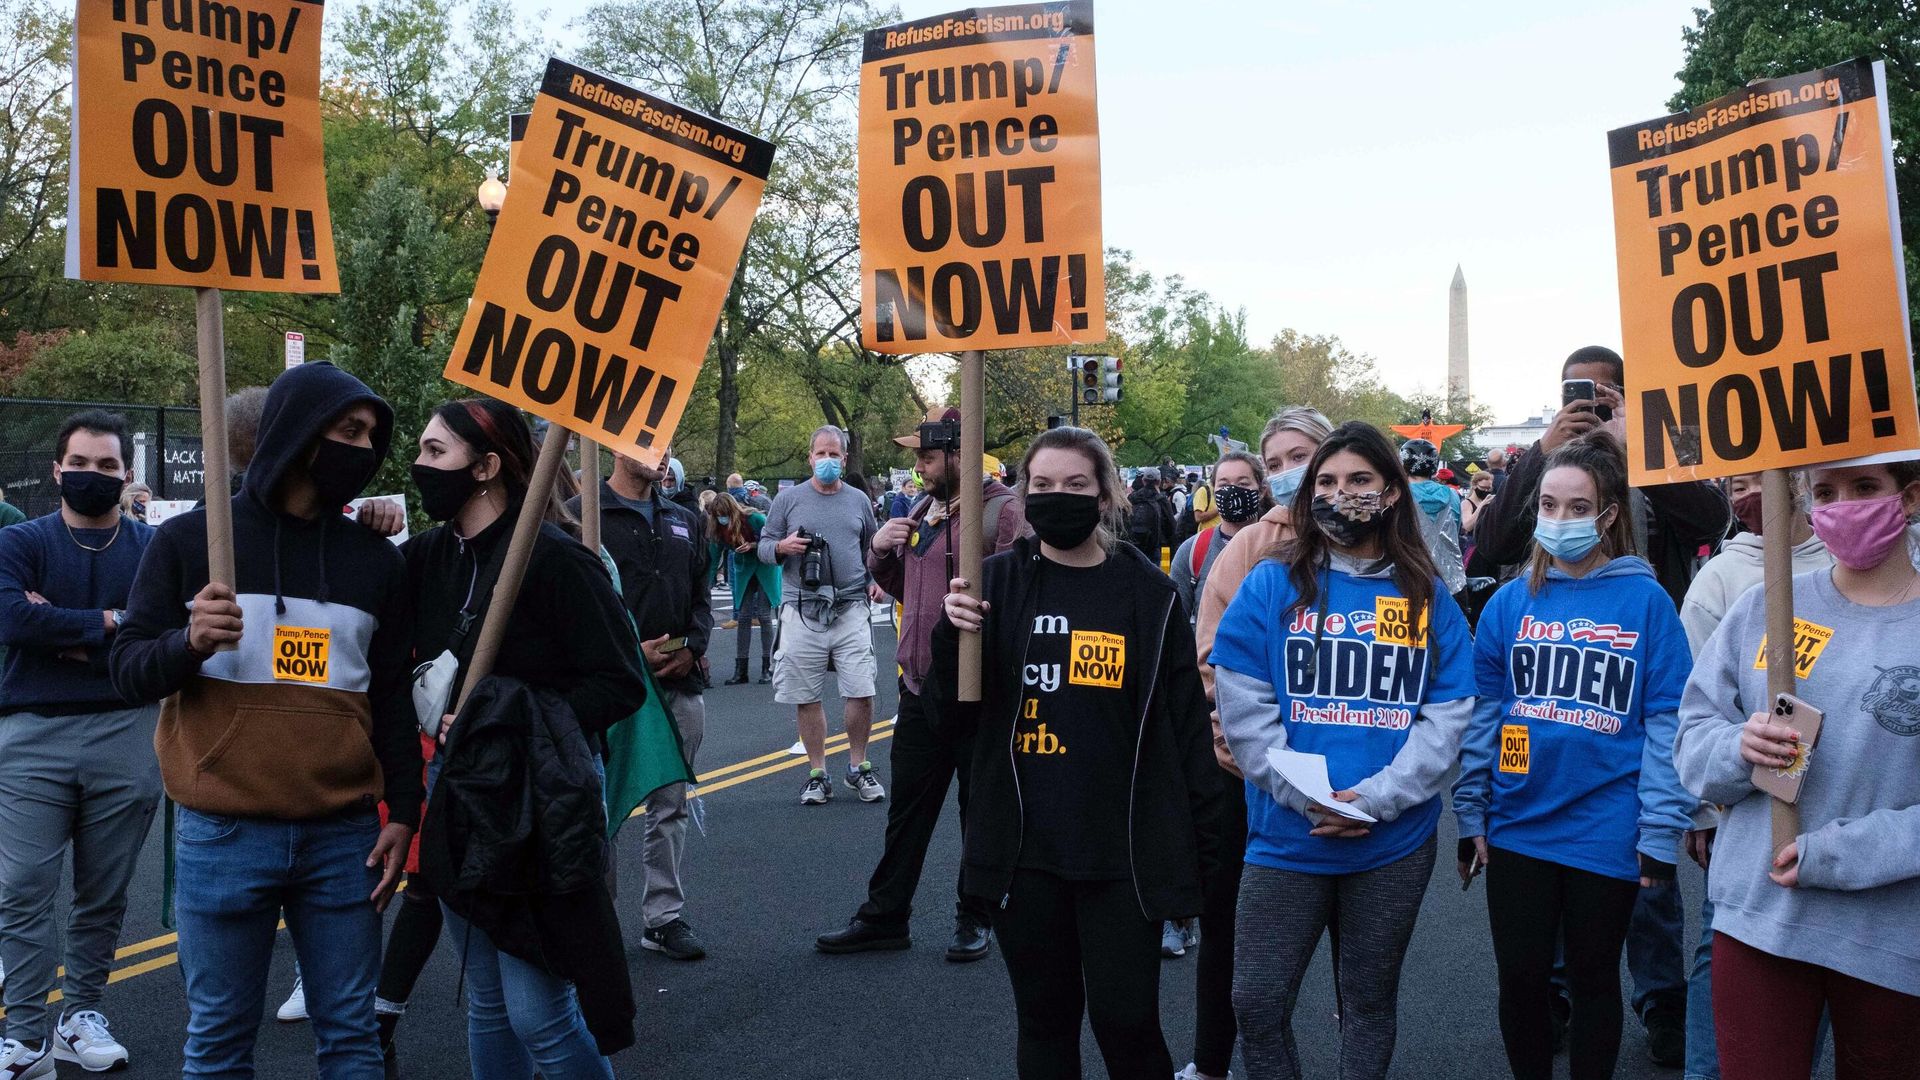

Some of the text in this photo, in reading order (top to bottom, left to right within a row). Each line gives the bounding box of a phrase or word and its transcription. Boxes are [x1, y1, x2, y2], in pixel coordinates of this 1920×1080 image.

[886, 11, 1064, 50] RefuseFascism.org
[121, 32, 286, 108] Pence
[880, 43, 1070, 111] Trump/
[132, 98, 284, 193] OUT
[570, 73, 747, 163] RefuseFascism.org
[893, 114, 1059, 166] Pence
[1637, 76, 1841, 151] RefuseFascism.org
[552, 109, 743, 221] Trump/
[1636, 111, 1850, 219] Trump/
[96, 187, 322, 281] NOW!
[542, 168, 701, 272] Pence
[902, 165, 1056, 253] OUT
[1658, 194, 1840, 277] Pence
[526, 234, 683, 352] OUT
[875, 254, 1089, 343] NOW!
[1671, 251, 1839, 368] OUT
[462, 301, 678, 449] NOW!
[1641, 348, 1897, 471] NOW!
[164, 449, 197, 464] LACK
[276, 628, 330, 640] Trump/Pence
[281, 640, 323, 659] OUT
[1074, 633, 1124, 645] Trump/Pence
[1289, 605, 1346, 634] Joe
[1383, 608, 1410, 624] OU
[1516, 615, 1564, 641] Joe
[1794, 632, 1821, 653] UT
[276, 657, 327, 677] NOW
[1073, 660, 1123, 682] NOW
[1079, 644, 1120, 663] OUT
[1284, 636, 1428, 705] BIDEN
[1511, 643, 1637, 715] BIDEN
[1290, 700, 1411, 731] President 2020
[1505, 737, 1527, 752] OUT
[1583, 709, 1622, 735] 2020
[1501, 752, 1529, 768] NOW
